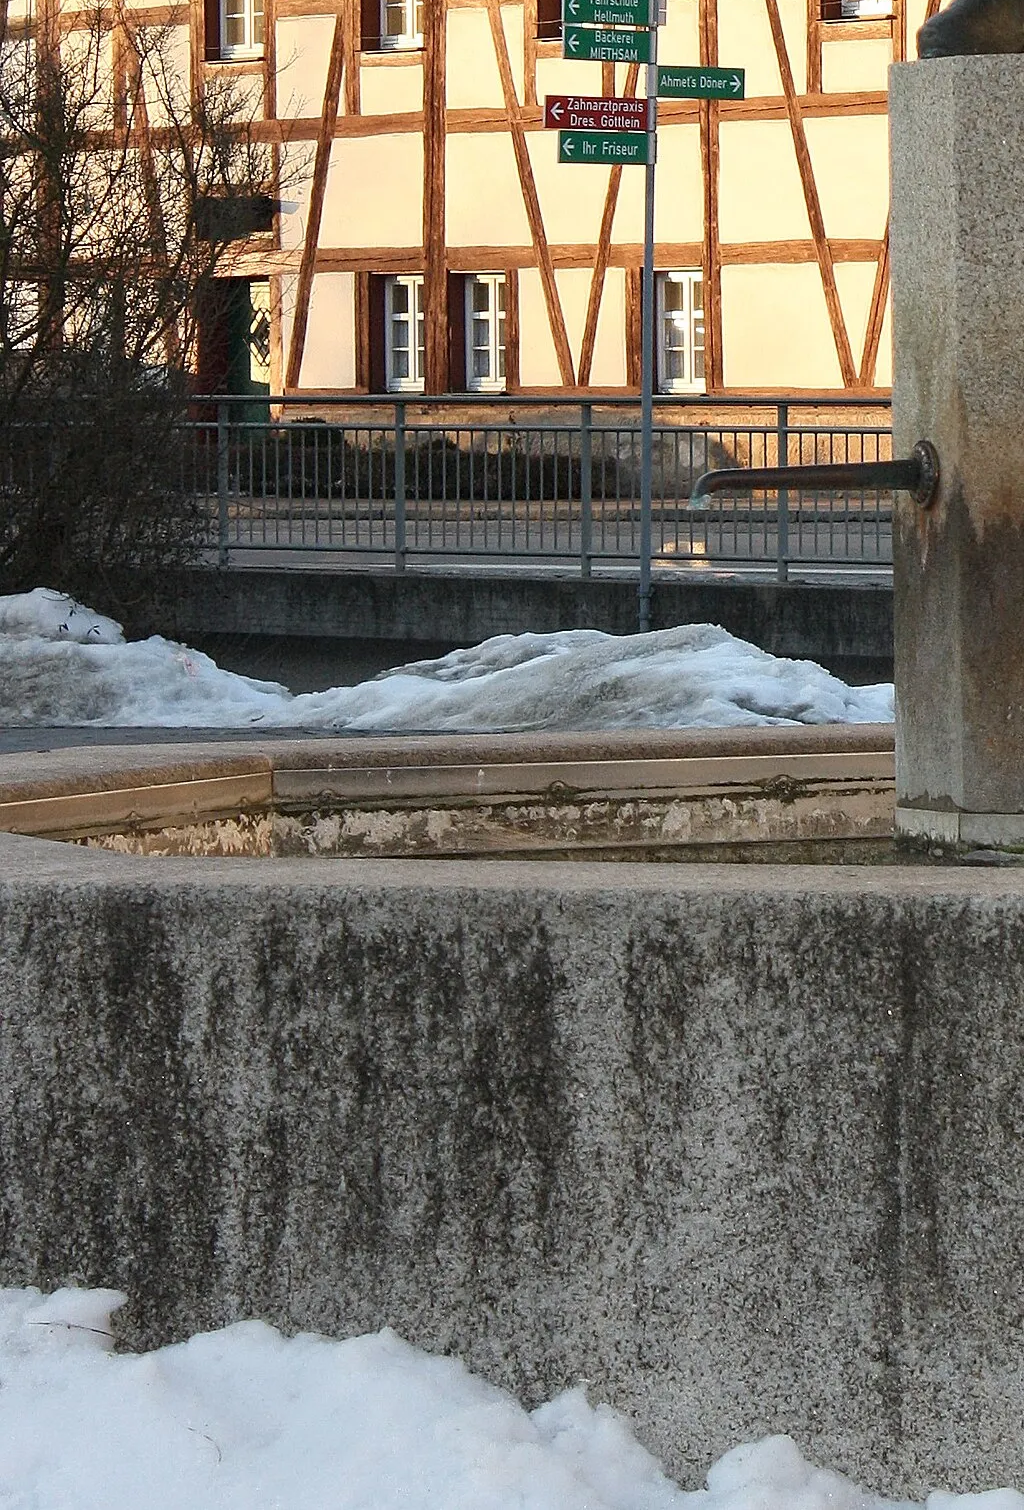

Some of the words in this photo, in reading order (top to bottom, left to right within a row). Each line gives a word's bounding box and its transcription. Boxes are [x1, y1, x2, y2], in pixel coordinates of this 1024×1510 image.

[594, 10, 634, 24] Hellmuth
[595, 31, 634, 44] Bäckerei
[590, 48, 638, 60] MIETHSAM
[700, 75, 727, 89] Döner
[567, 98, 644, 113] Zahnarztpraxis
[570, 115, 596, 126] Dres.
[601, 115, 640, 128] Göttlein
[582, 141, 596, 154] Ihr
[602, 142, 638, 156] Friseur
